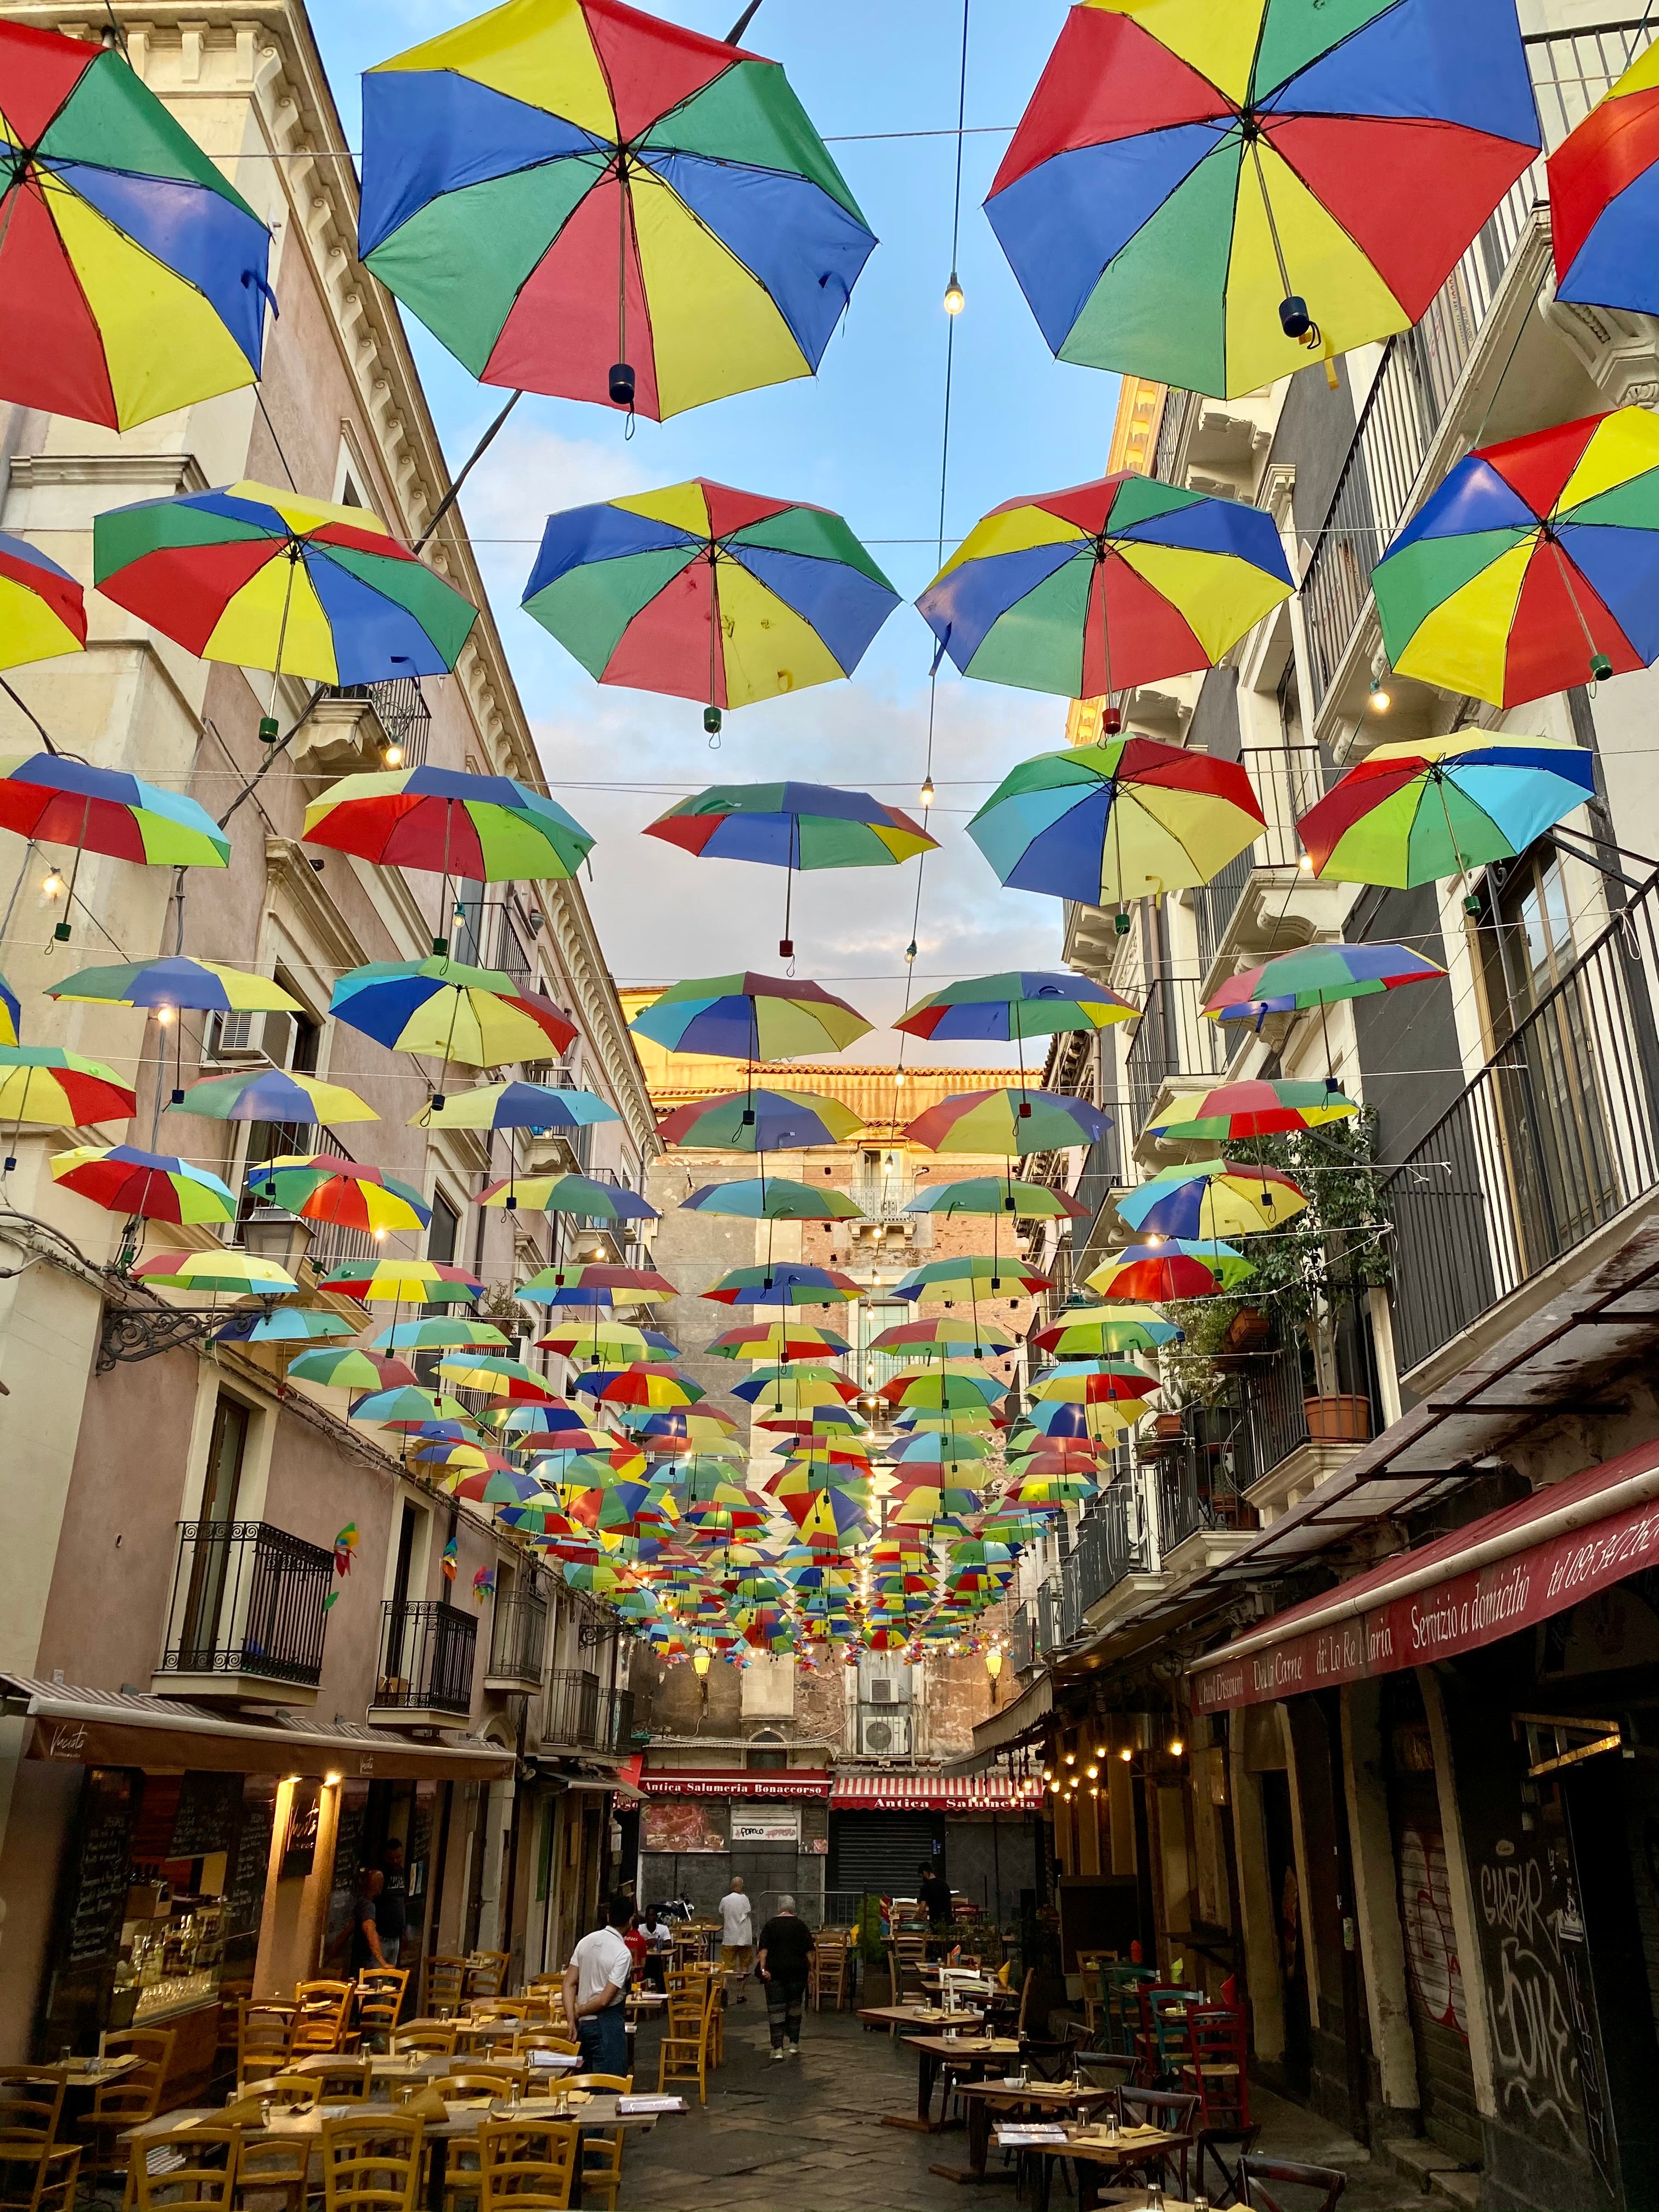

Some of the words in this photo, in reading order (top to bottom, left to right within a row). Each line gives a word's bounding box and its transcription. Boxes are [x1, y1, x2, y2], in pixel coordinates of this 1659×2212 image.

[1252, 1657, 1274, 1690] Della
[1276, 1652, 1302, 1685] Carne
[1329, 1636, 1340, 1671] Lo
[1343, 1631, 1356, 1668] Re
[1358, 1622, 1393, 1664] Maria
[1411, 1593, 1458, 1649] Servizio
[1460, 1602, 1469, 1635] a
[1471, 1564, 1530, 1632] domicilio
[1547, 1550, 1572, 1599] tel
[1565, 1539, 1604, 1589] 095
[644, 1781, 681, 1792] Antica
[687, 1782, 748, 1793] Salumeria
[754, 1784, 822, 1794] Bonaccorso
[874, 1798, 929, 1808] Antica
